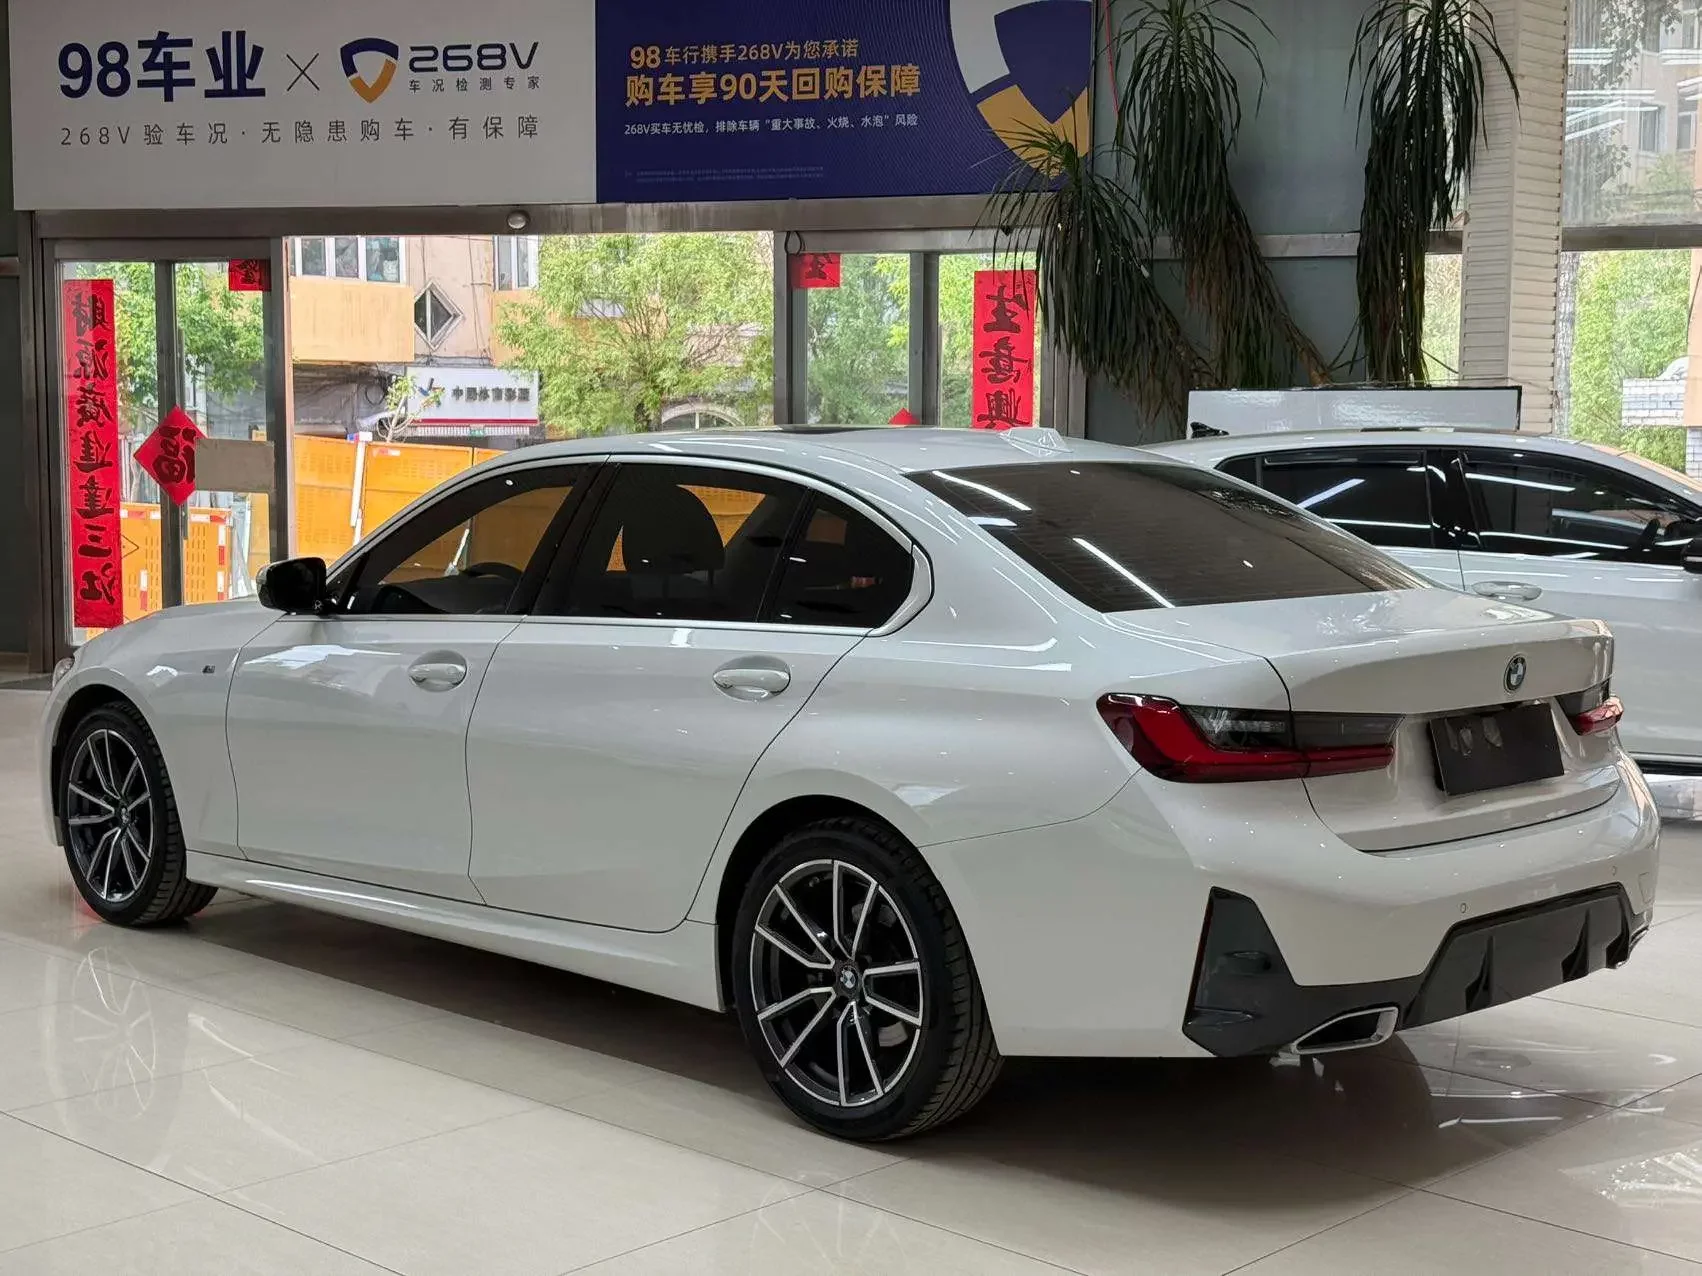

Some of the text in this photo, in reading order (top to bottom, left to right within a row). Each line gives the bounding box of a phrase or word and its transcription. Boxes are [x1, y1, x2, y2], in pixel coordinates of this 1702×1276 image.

[57, 30, 266, 102] 98车业
[408, 40, 540, 73] 268V
[409, 75, 541, 93] 车况检测专家
[624, 63, 922, 108] 购车享90天回购保障
